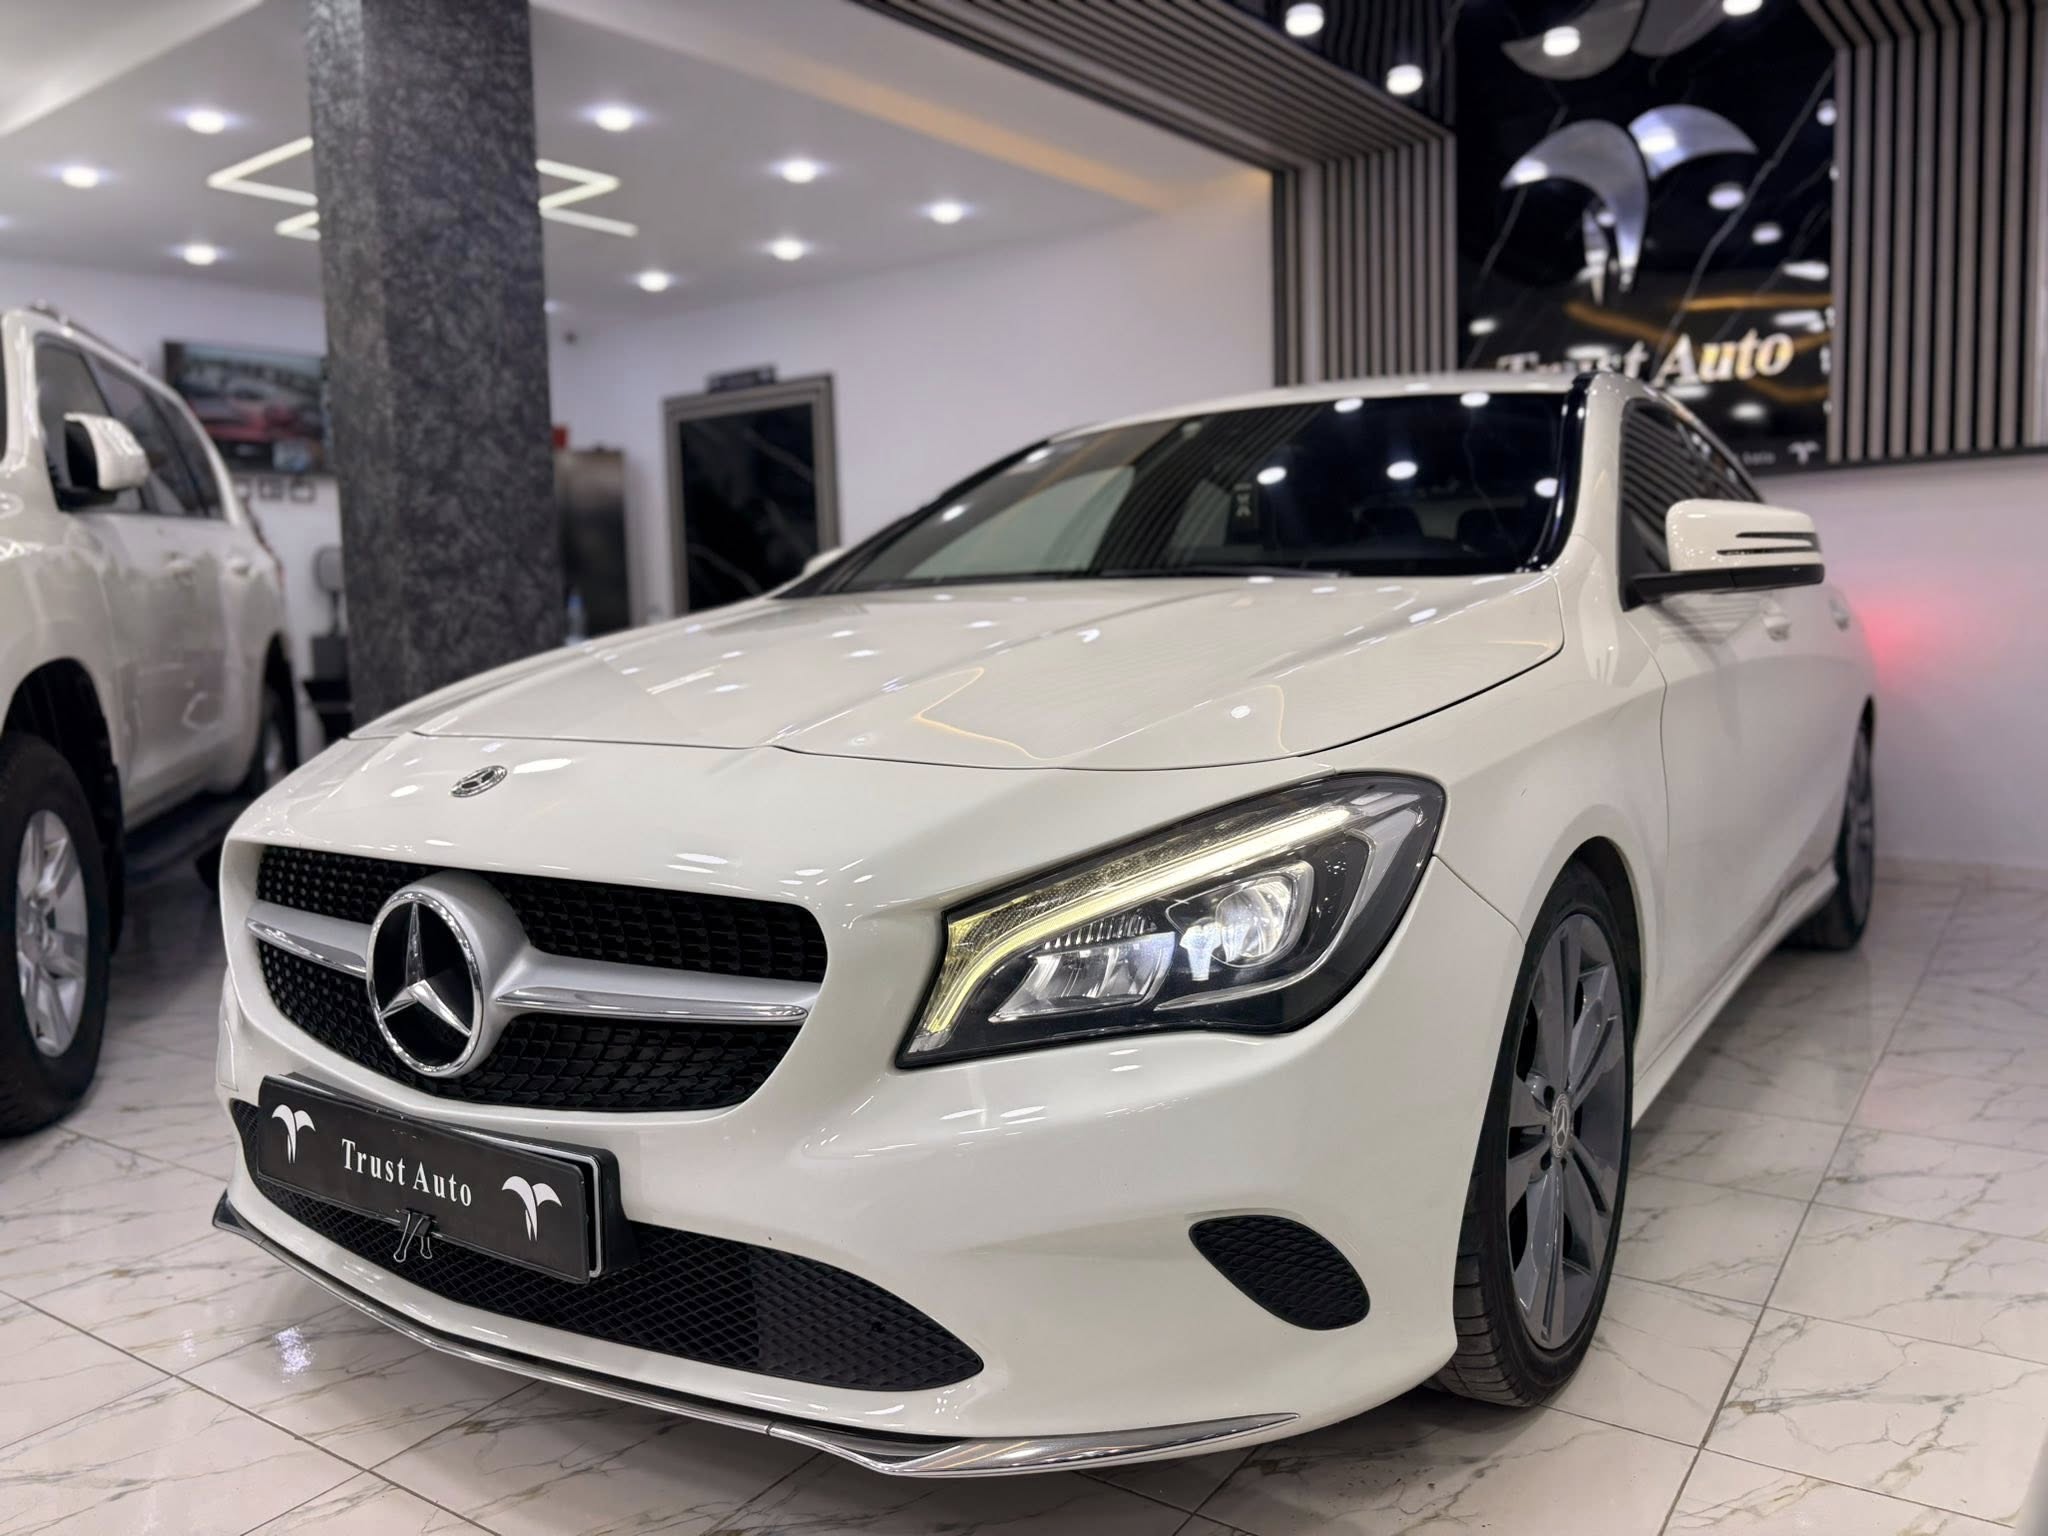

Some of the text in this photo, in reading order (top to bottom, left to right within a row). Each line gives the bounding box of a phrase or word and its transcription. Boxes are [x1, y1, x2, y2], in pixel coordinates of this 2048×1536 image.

[1652, 328, 1795, 387] Auto
[341, 1138, 472, 1207] Trust Auto
